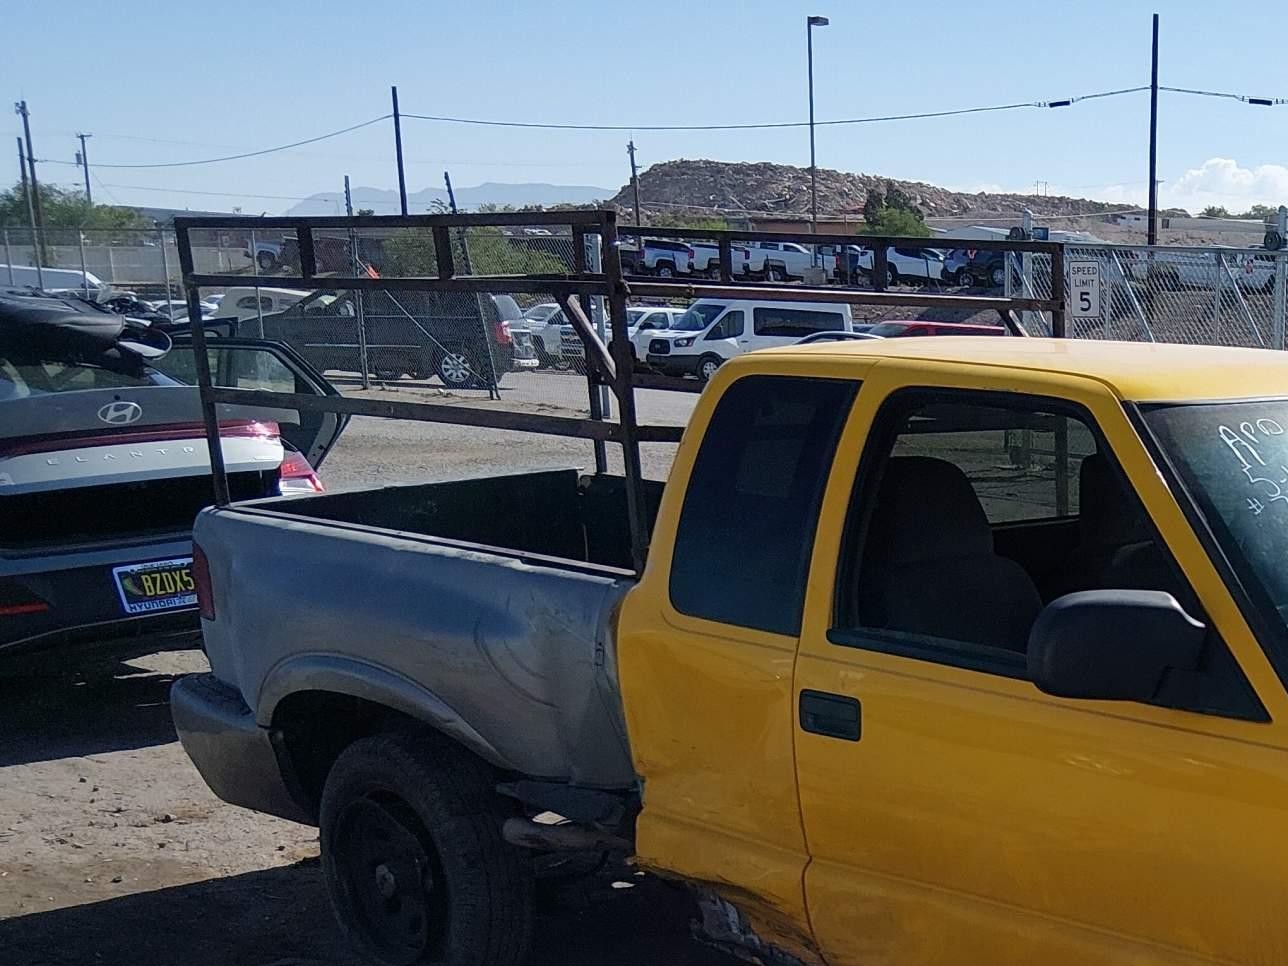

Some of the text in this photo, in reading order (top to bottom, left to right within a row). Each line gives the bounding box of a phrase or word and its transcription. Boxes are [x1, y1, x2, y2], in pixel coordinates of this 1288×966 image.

[1071, 266, 1097, 275] SPEED
[1074, 279, 1094, 287] LIMIT
[1079, 291, 1092, 312] 5
[1218, 418, 1284, 466] APD
[46, 446, 195, 466] ELANTR
[141, 569, 196, 597] BZDX5
